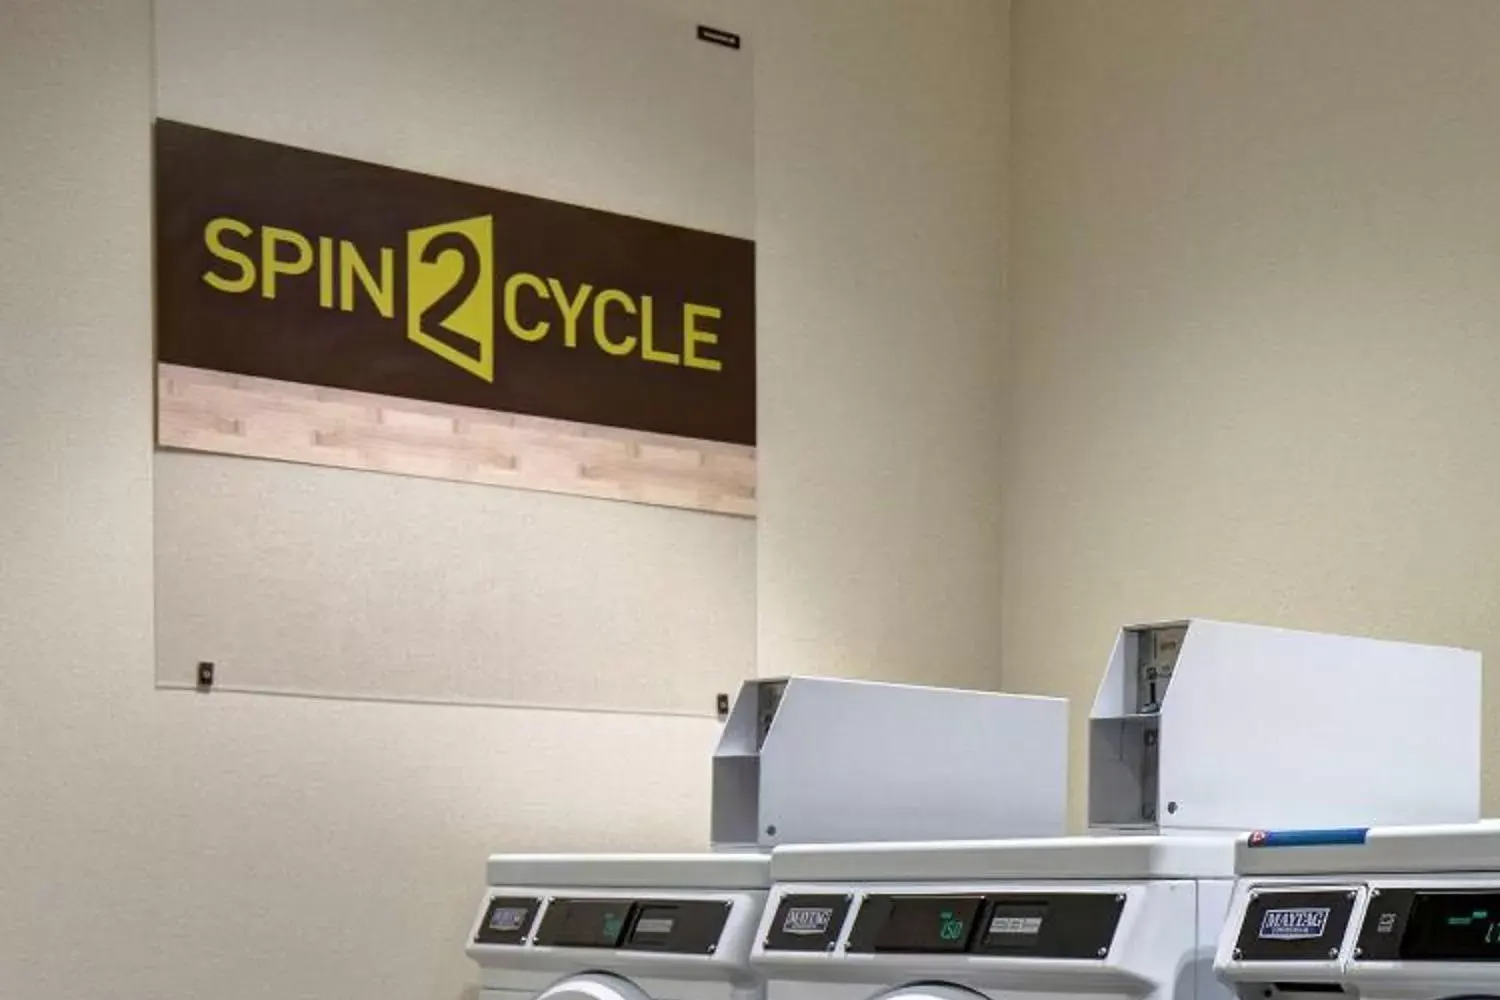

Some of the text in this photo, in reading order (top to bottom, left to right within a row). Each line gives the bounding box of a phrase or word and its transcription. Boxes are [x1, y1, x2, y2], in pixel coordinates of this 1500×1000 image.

[202, 216, 396, 319] SPIN
[503, 272, 723, 372] CYCLE
[1266, 911, 1324, 928] MAYTAG
